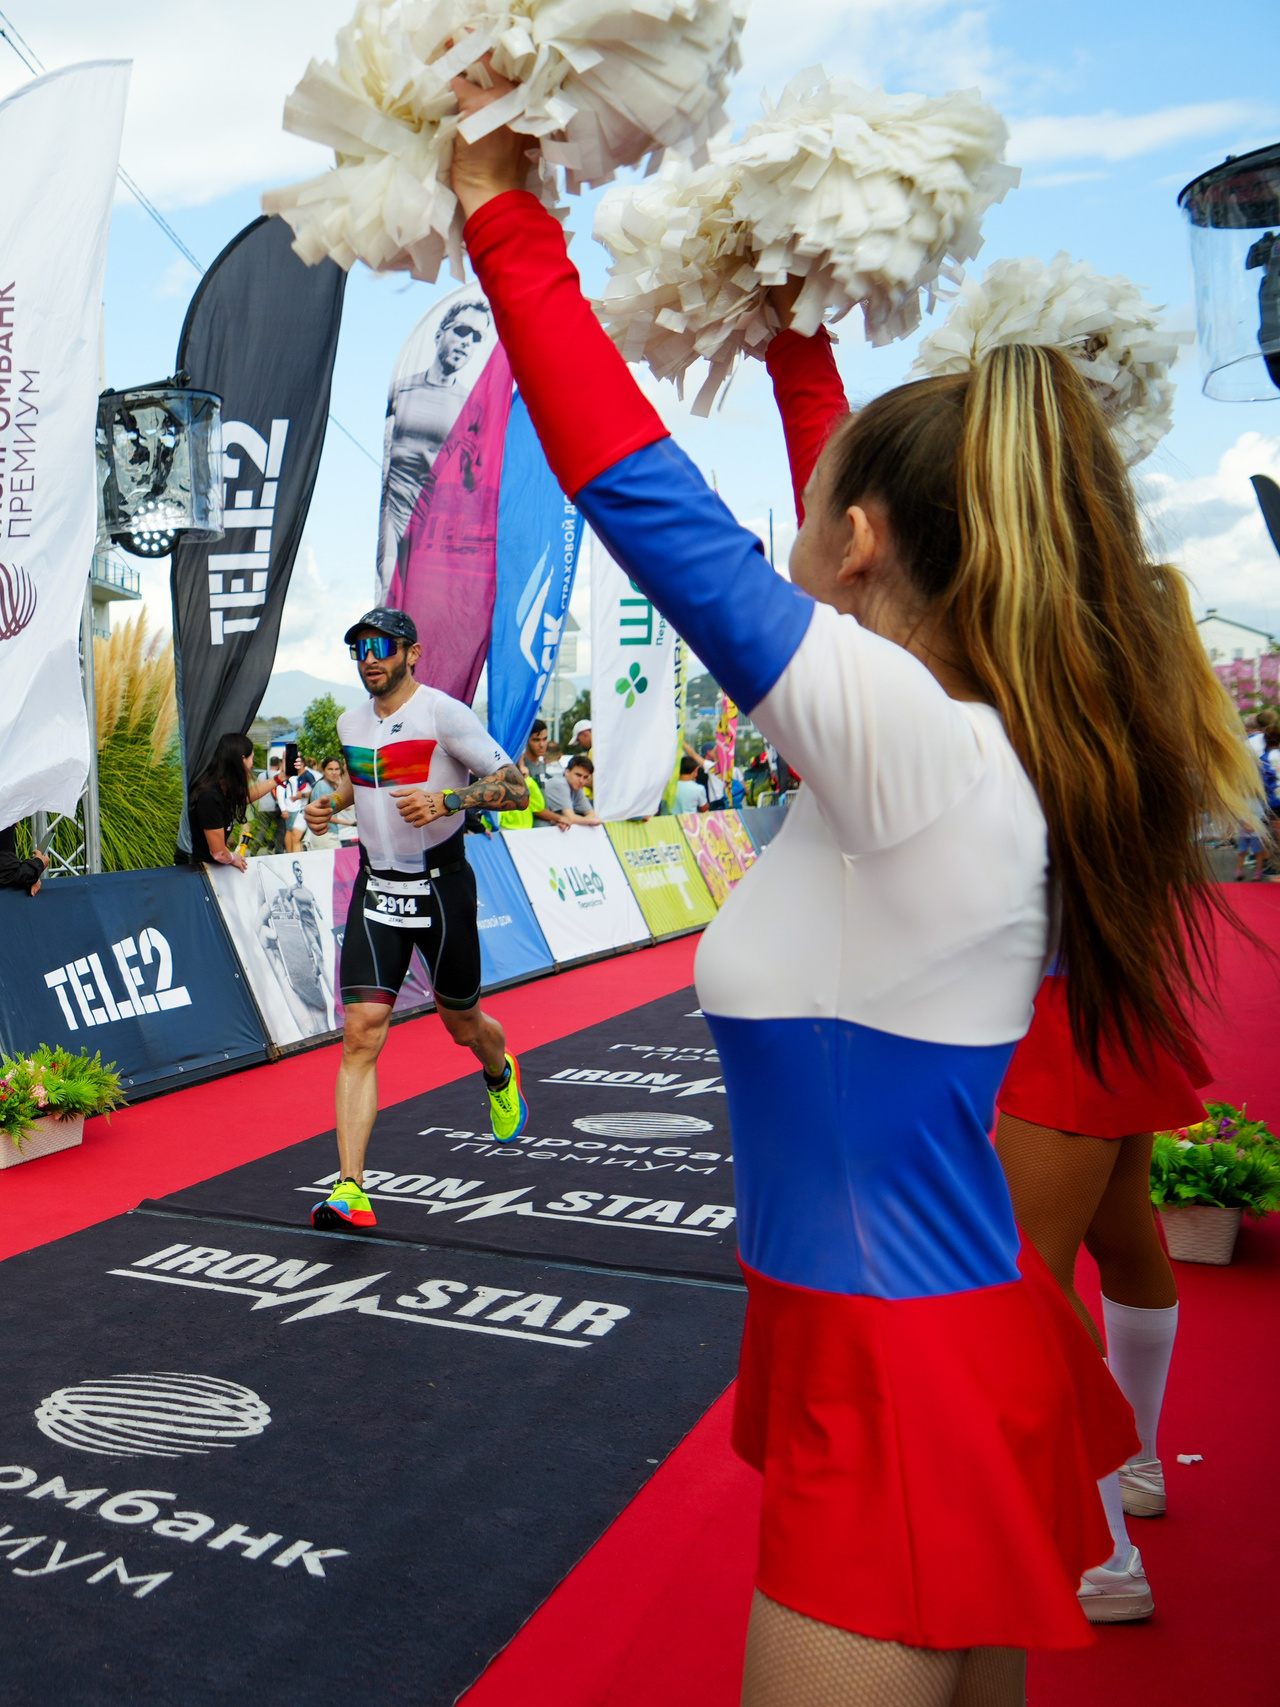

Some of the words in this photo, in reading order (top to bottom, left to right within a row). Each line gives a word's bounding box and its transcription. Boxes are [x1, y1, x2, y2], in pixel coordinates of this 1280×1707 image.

[6, 368, 42, 539] ПРЕМИУМ
[208, 418, 291, 645] TELE2
[376, 894, 418, 915] 2914
[563, 864, 606, 900] Шеф
[43, 926, 193, 1031] TELE2
[549, 1068, 683, 1085] IRON
[418, 1127, 732, 1162] Газпромба
[449, 1142, 718, 1175] Премиум
[312, 1169, 486, 1199] IRON
[547, 1191, 737, 1230] STAR
[131, 1243, 336, 1288] IRON
[396, 1280, 632, 1336] STAR
